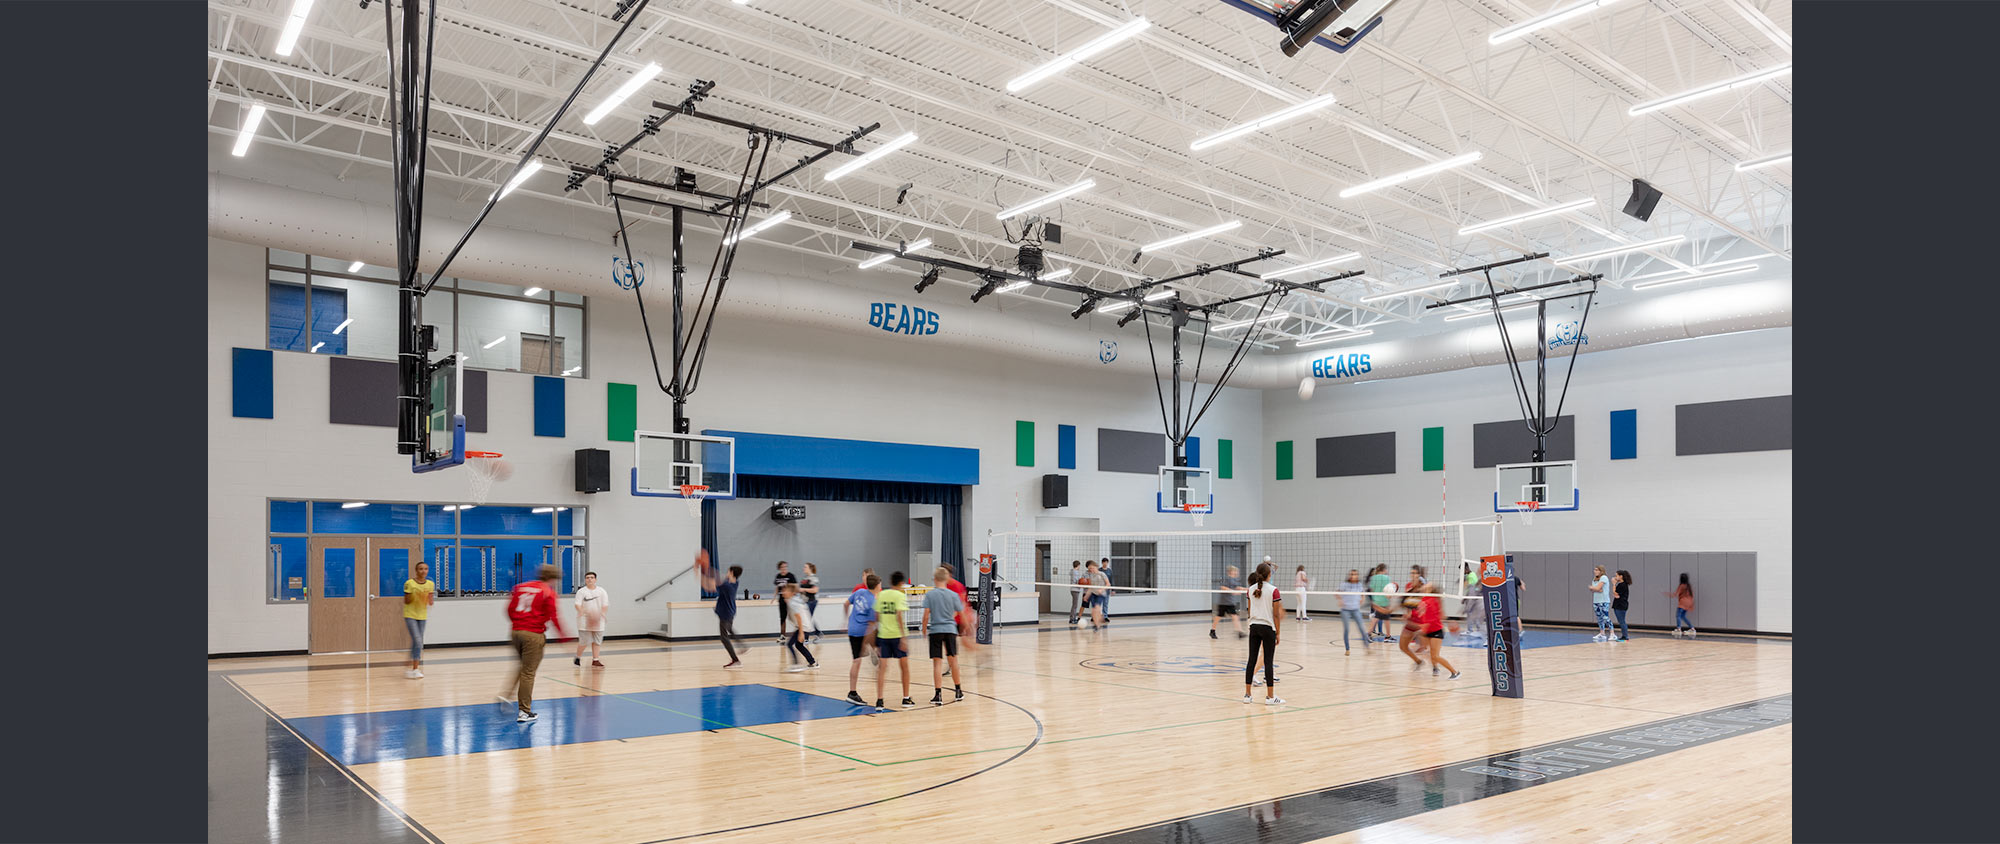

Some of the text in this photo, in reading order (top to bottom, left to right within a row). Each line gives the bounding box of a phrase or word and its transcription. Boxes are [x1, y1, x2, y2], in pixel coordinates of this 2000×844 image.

[868, 302, 940, 335] BEARS
[1312, 354, 1372, 378] BEARS
[978, 576, 988, 640] BEARS
[1488, 591, 1510, 692] BEARS
[1460, 741, 1656, 782] BATTLE
